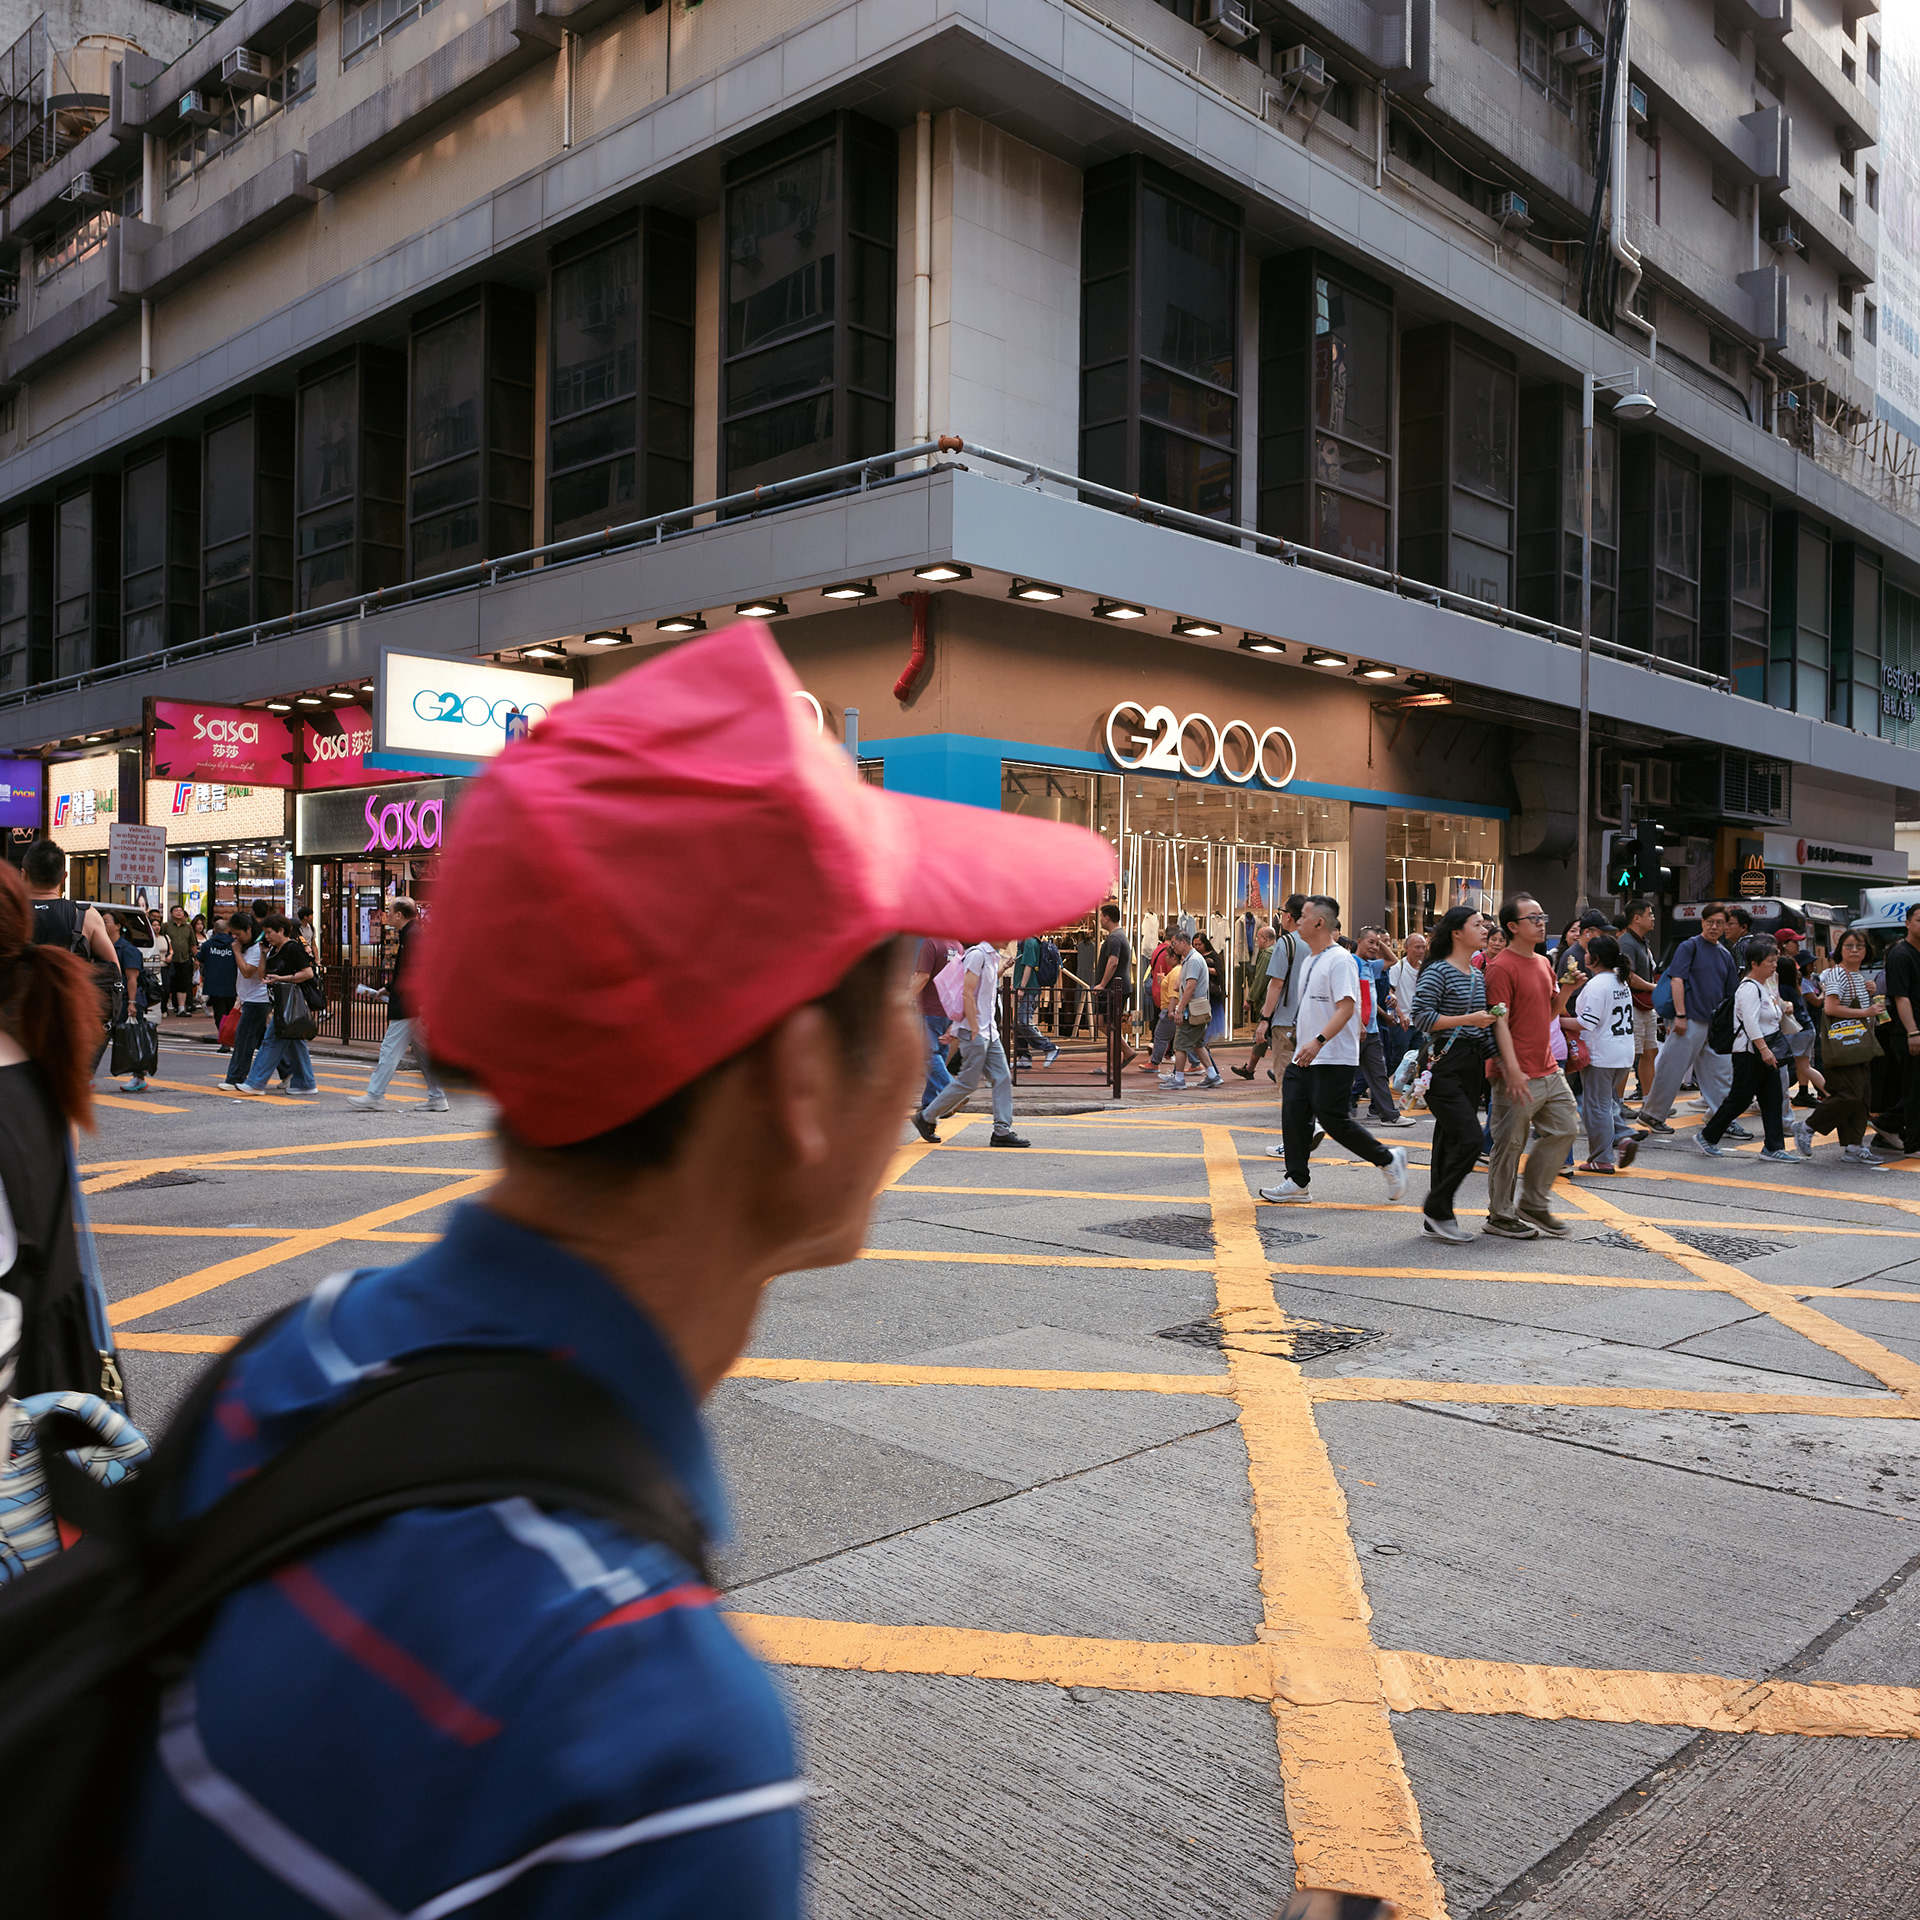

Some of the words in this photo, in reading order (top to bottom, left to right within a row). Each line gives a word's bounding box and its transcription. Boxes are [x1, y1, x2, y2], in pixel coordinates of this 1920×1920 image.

[1881, 664, 1914, 698] restige
[212, 743, 239, 759] 莎莎
[1106, 701, 1296, 787] G2000
[120, 839, 156, 847] prosecuted
[210, 947, 233, 956] Magic
[1611, 1004, 1634, 1036] 23
